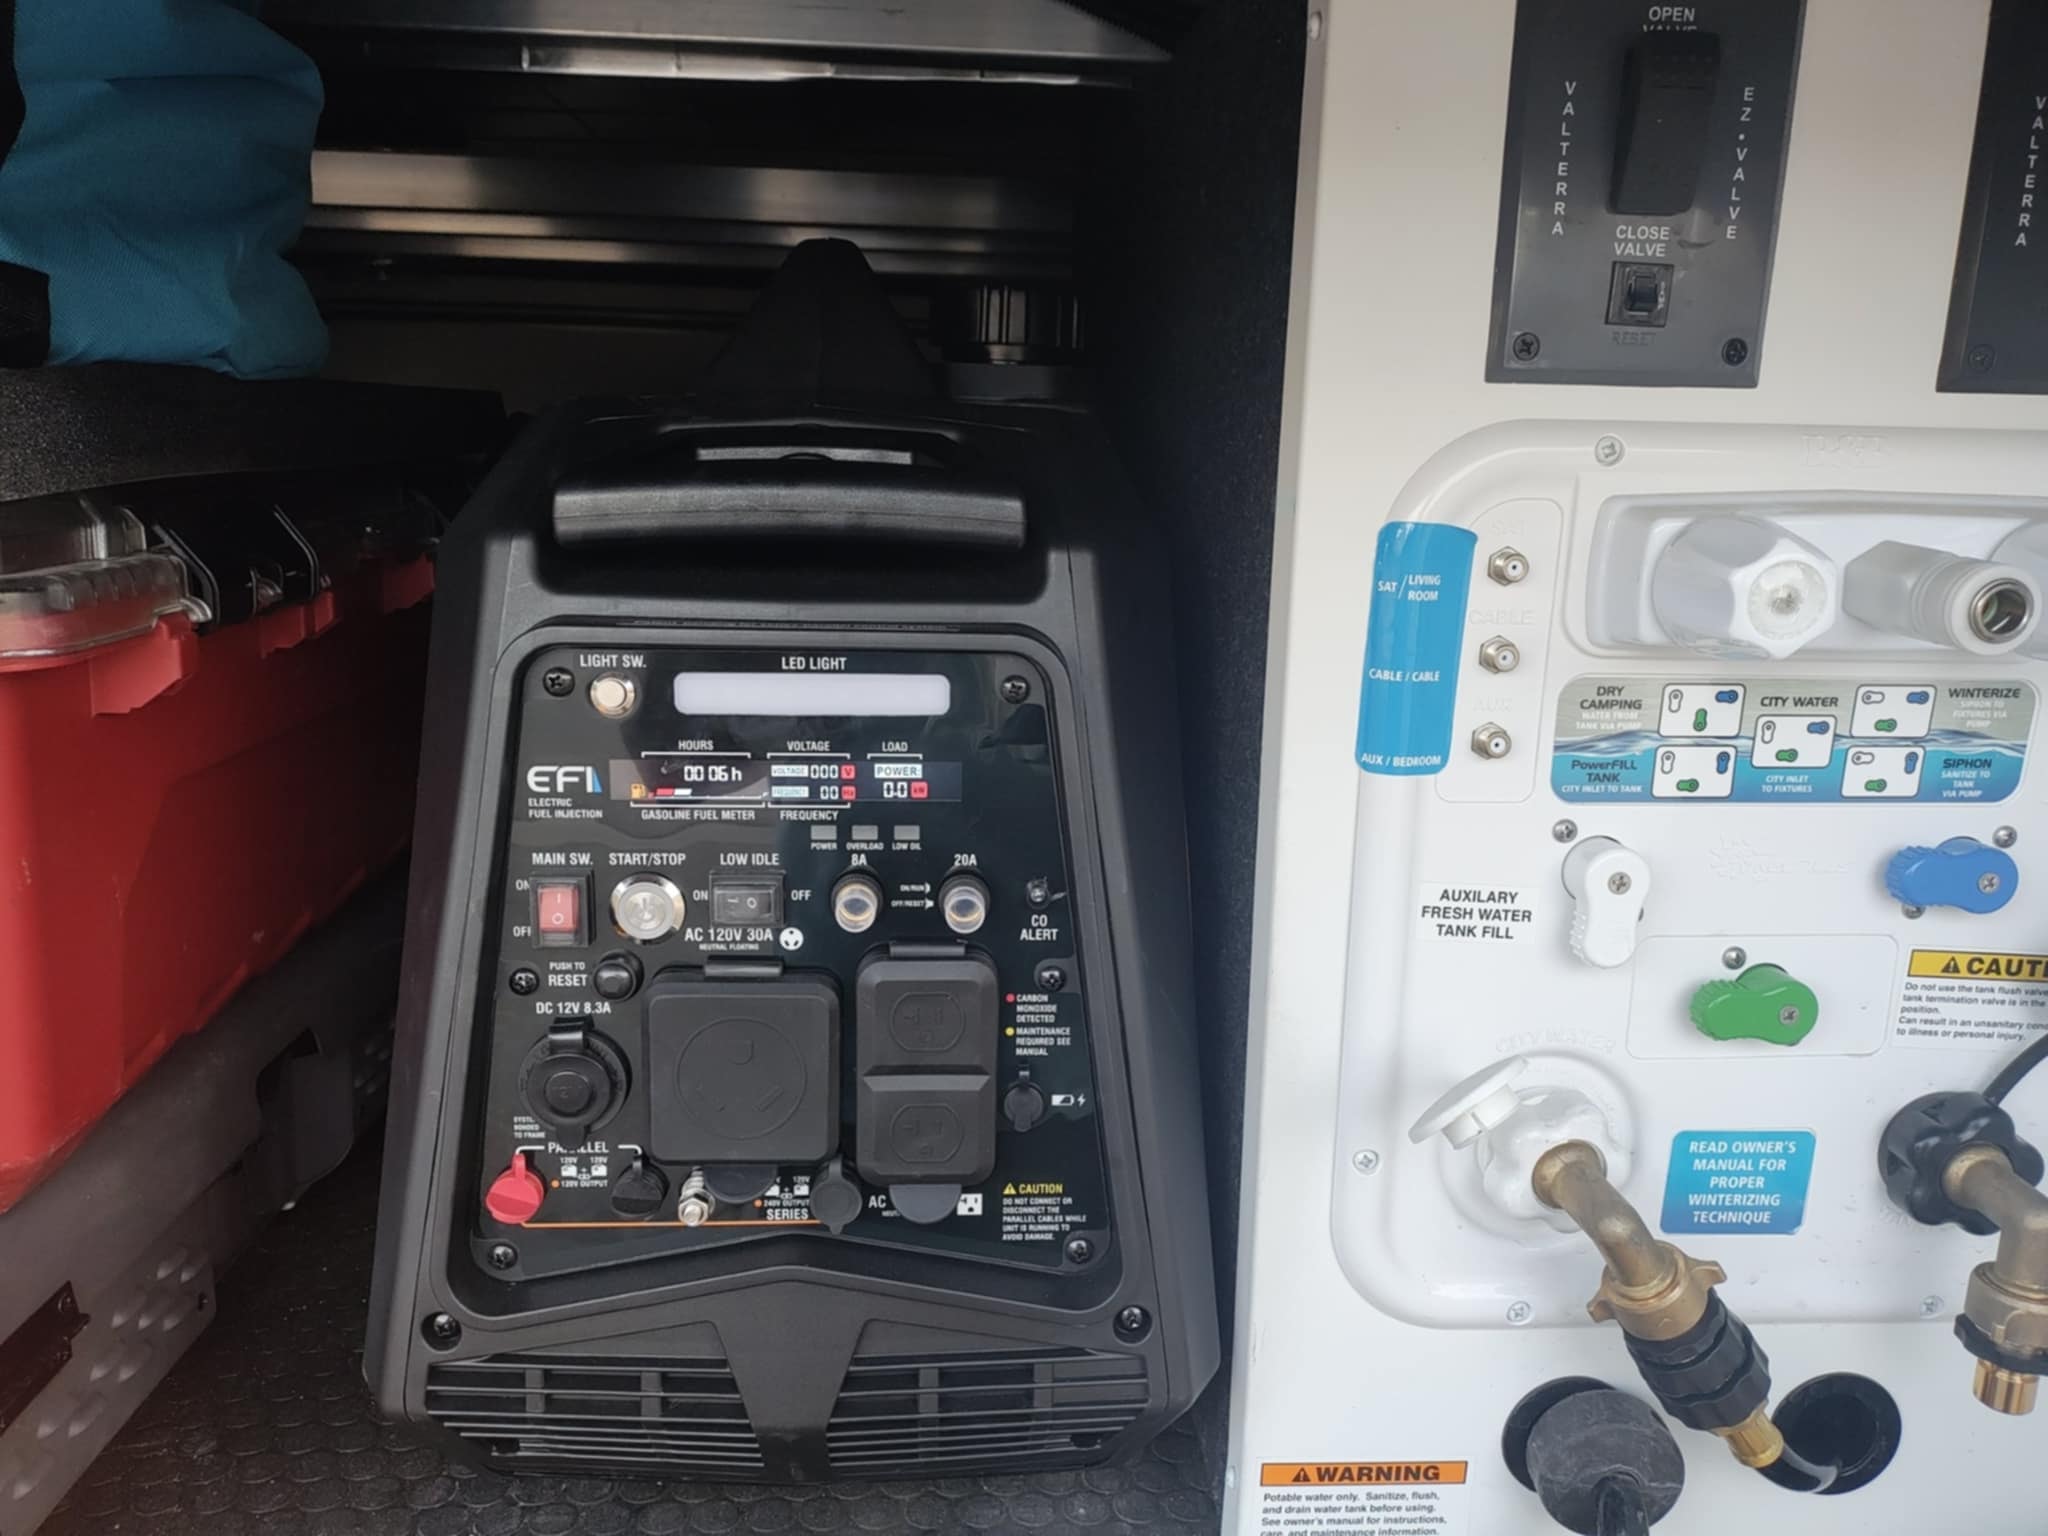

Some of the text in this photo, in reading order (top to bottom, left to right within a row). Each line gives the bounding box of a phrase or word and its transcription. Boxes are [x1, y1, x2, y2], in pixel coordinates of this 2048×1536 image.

[1648, 6, 1696, 22] OPEN
[1551, 81, 1577, 236] VALTERRA
[2015, 96, 2047, 246] VALTERRA
[1616, 225, 1670, 241] CLOSE
[1614, 242, 1666, 257] VALVE
[1377, 574, 1441, 592] SAT LIVING
[1408, 590, 1438, 600] ROOM
[580, 655, 646, 668] LIGHT SW.
[781, 657, 847, 670] LED LIGHT
[1369, 668, 1440, 682] CABLE CABLE
[1596, 686, 1625, 697] DRY
[1948, 688, 2021, 699] WINTERIZE
[1580, 699, 1643, 710] CAMPING
[1760, 696, 1839, 707] CITY WATER
[678, 740, 714, 750] HOURS
[787, 741, 830, 751] VOLTAGE
[882, 742, 908, 752] LOAD
[1361, 754, 1441, 767] AUX BEDROOM
[1571, 760, 1638, 770] PowerFILL
[1943, 758, 1992, 768] SIPHON
[1586, 772, 1620, 782] TANK
[1766, 775, 1809, 783] CITY INLET
[1761, 785, 1812, 793] TO FIXTURES
[528, 798, 572, 808] ELECTRIC
[528, 809, 603, 818] FUEL INJECTION
[641, 809, 755, 820] GASOLINE FUEL METER
[780, 810, 838, 821] FREQUENCY
[811, 842, 837, 850] POWER
[846, 842, 884, 850] OVERLOAD
[892, 842, 921, 850] LOW OIL
[532, 853, 593, 865] MAIN SW.
[609, 853, 686, 866] START/STOP
[720, 853, 780, 866] LOW IDLE
[851, 854, 867, 866] 8A
[954, 854, 977, 866] 20A
[692, 890, 708, 901] ON
[791, 890, 811, 901] OFF
[1440, 888, 1518, 904] AUXILARY
[1421, 906, 1532, 922] FRESH WATER
[1031, 914, 1048, 927] CO
[684, 927, 774, 941] AC 120V 30A
[1020, 928, 1058, 941] ALERT
[1436, 924, 1514, 939] TANK FILL
[549, 962, 586, 971] PUSH TO
[548, 974, 587, 987] RESET
[1904, 982, 1918, 991] Do
[1920, 983, 1936, 991] not
[1957, 984, 1973, 993] the
[1975, 985, 1995, 993] tank
[1998, 986, 2022, 994] flush
[1016, 994, 1048, 1002] CARBON
[1903, 994, 1922, 1002] tank
[1925, 995, 1979, 1004] termination
[2031, 999, 2046, 1007] the
[536, 1002, 611, 1014] DC 12V 8.3A
[1016, 1004, 1057, 1013] MONOXIDE
[1900, 1006, 1940, 1014] position.
[1016, 1014, 1055, 1023] DETECTED
[1899, 1016, 1917, 1024] Can
[1919, 1017, 1946, 1025] result
[1948, 1018, 1957, 1026] in
[1974, 1019, 2024, 1029] unsanitary
[1016, 1027, 1071, 1035] MAINTENANCE
[1897, 1027, 1905, 1035] to
[1908, 1028, 1939, 1036] illness
[1953, 1031, 1995, 1039] personal
[1016, 1037, 1071, 1046] REQUIRED SEE
[1016, 1047, 1048, 1056] MANUAL
[547, 1141, 609, 1154] PALLEL
[1689, 1141, 1796, 1153] READ OWNER'S
[1692, 1159, 1787, 1171] MANUAL FOR
[1709, 1176, 1766, 1189] PROPER
[1018, 1184, 1063, 1194] CAUTION
[868, 1195, 886, 1208] AC
[1688, 1194, 1781, 1206] WINTERIZING
[766, 1208, 809, 1220] SERIES
[1693, 1211, 1772, 1225] TECHNIQUE
[1315, 1465, 1441, 1482] WARNING
[1263, 1491, 1440, 1503] Potable water only. Sanitize, flush,
[1262, 1503, 1436, 1514] and drain water tank before using.
[1261, 1515, 1447, 1526] See owner's manual for instructions,
